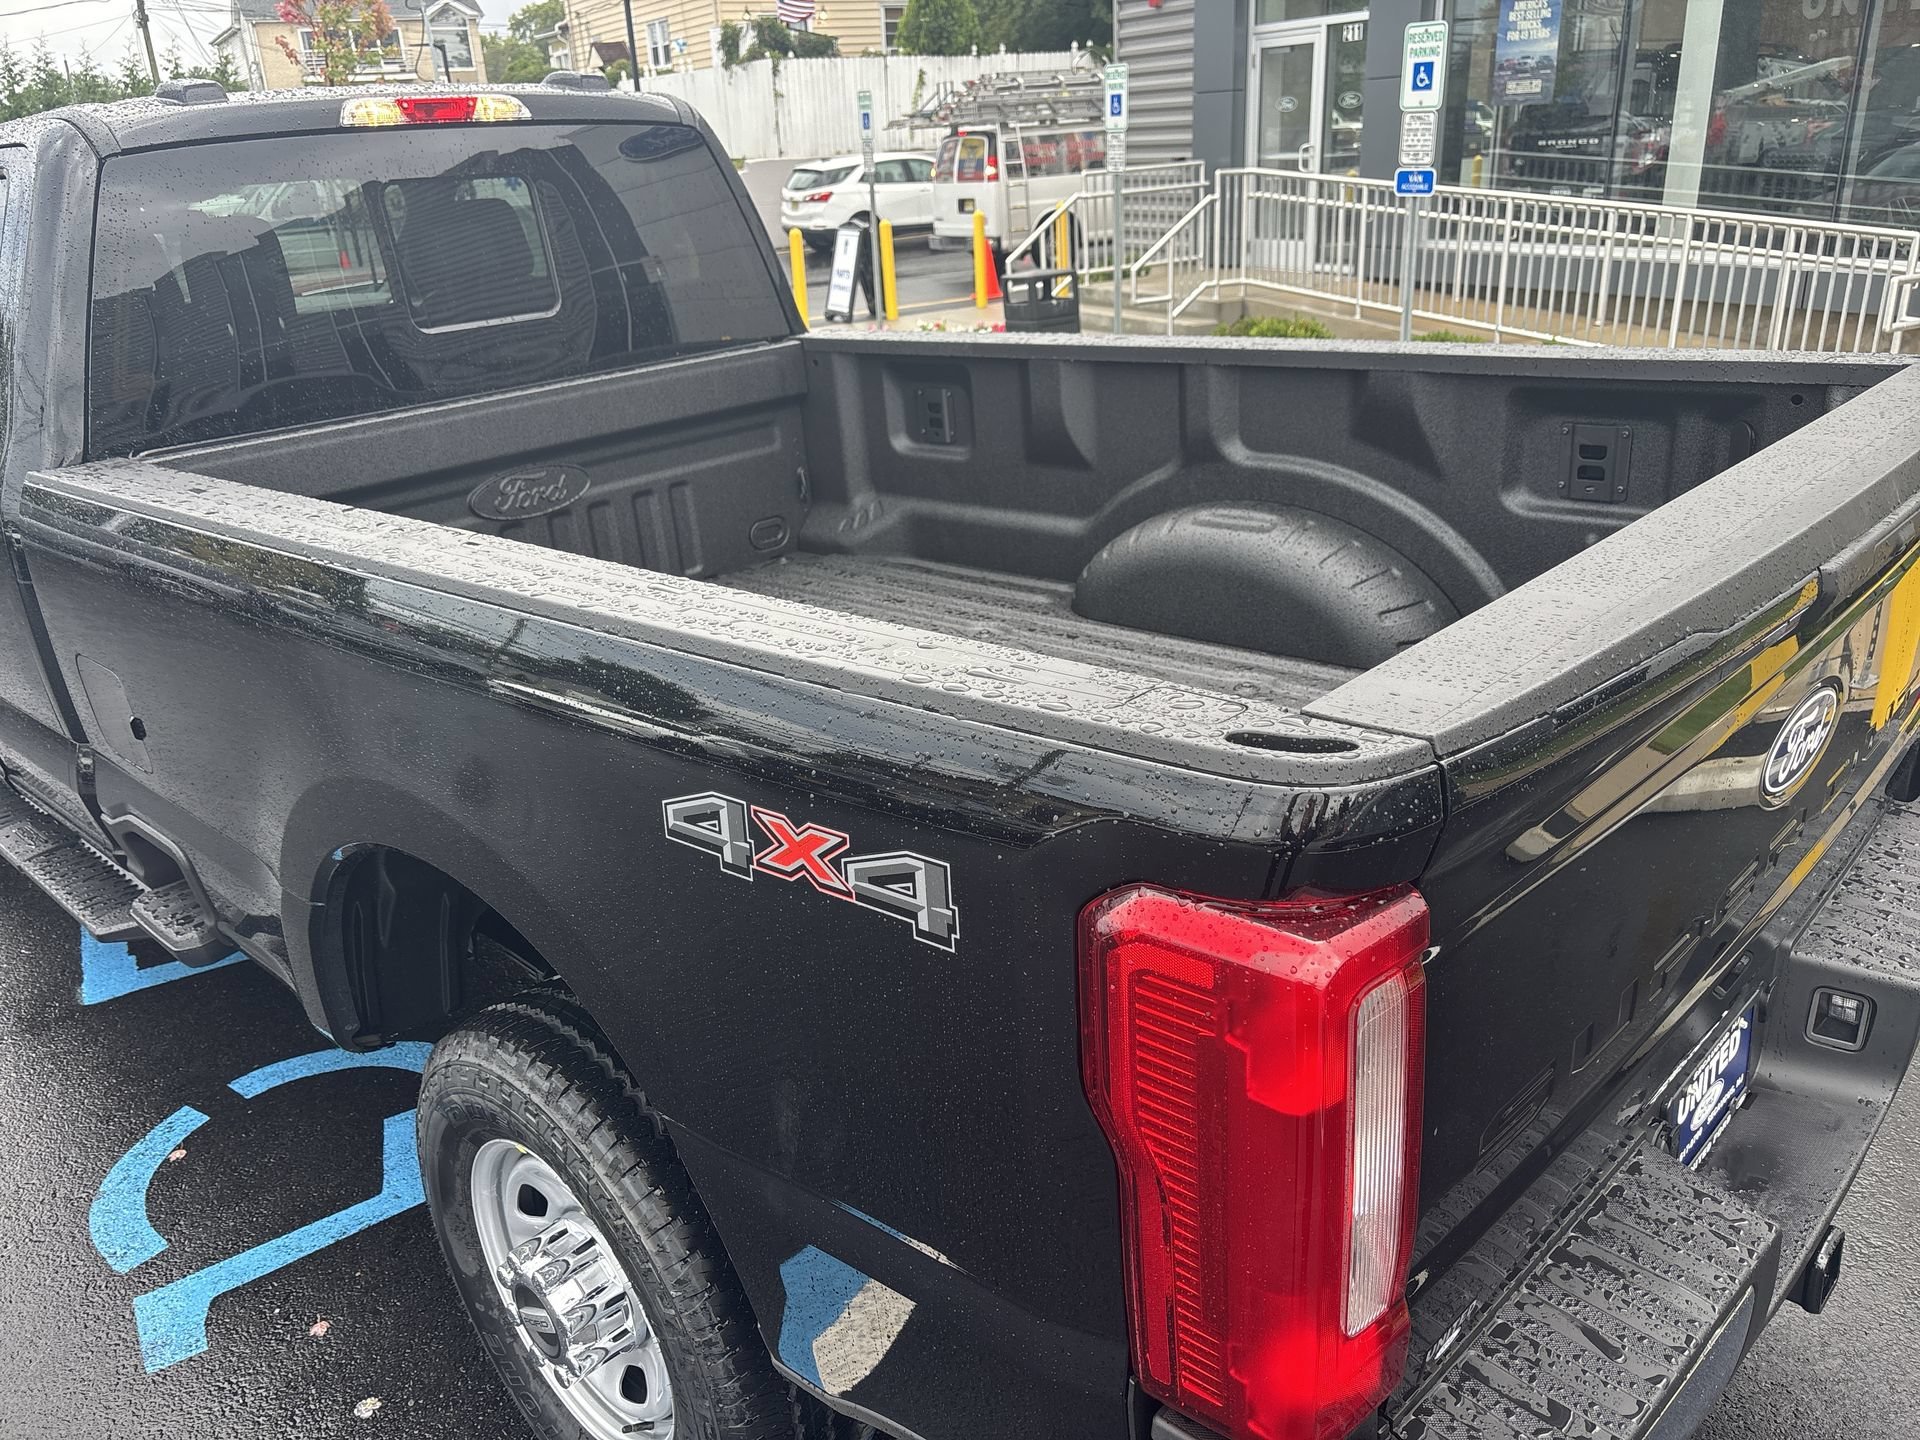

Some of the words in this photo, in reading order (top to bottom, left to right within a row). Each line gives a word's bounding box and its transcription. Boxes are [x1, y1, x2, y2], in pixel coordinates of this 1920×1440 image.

[1409, 45, 1441, 58] PARKING
[1408, 174, 1424, 183] VAN
[1777, 704, 1830, 784] Ford
[1677, 1029, 1741, 1125] UNITED
